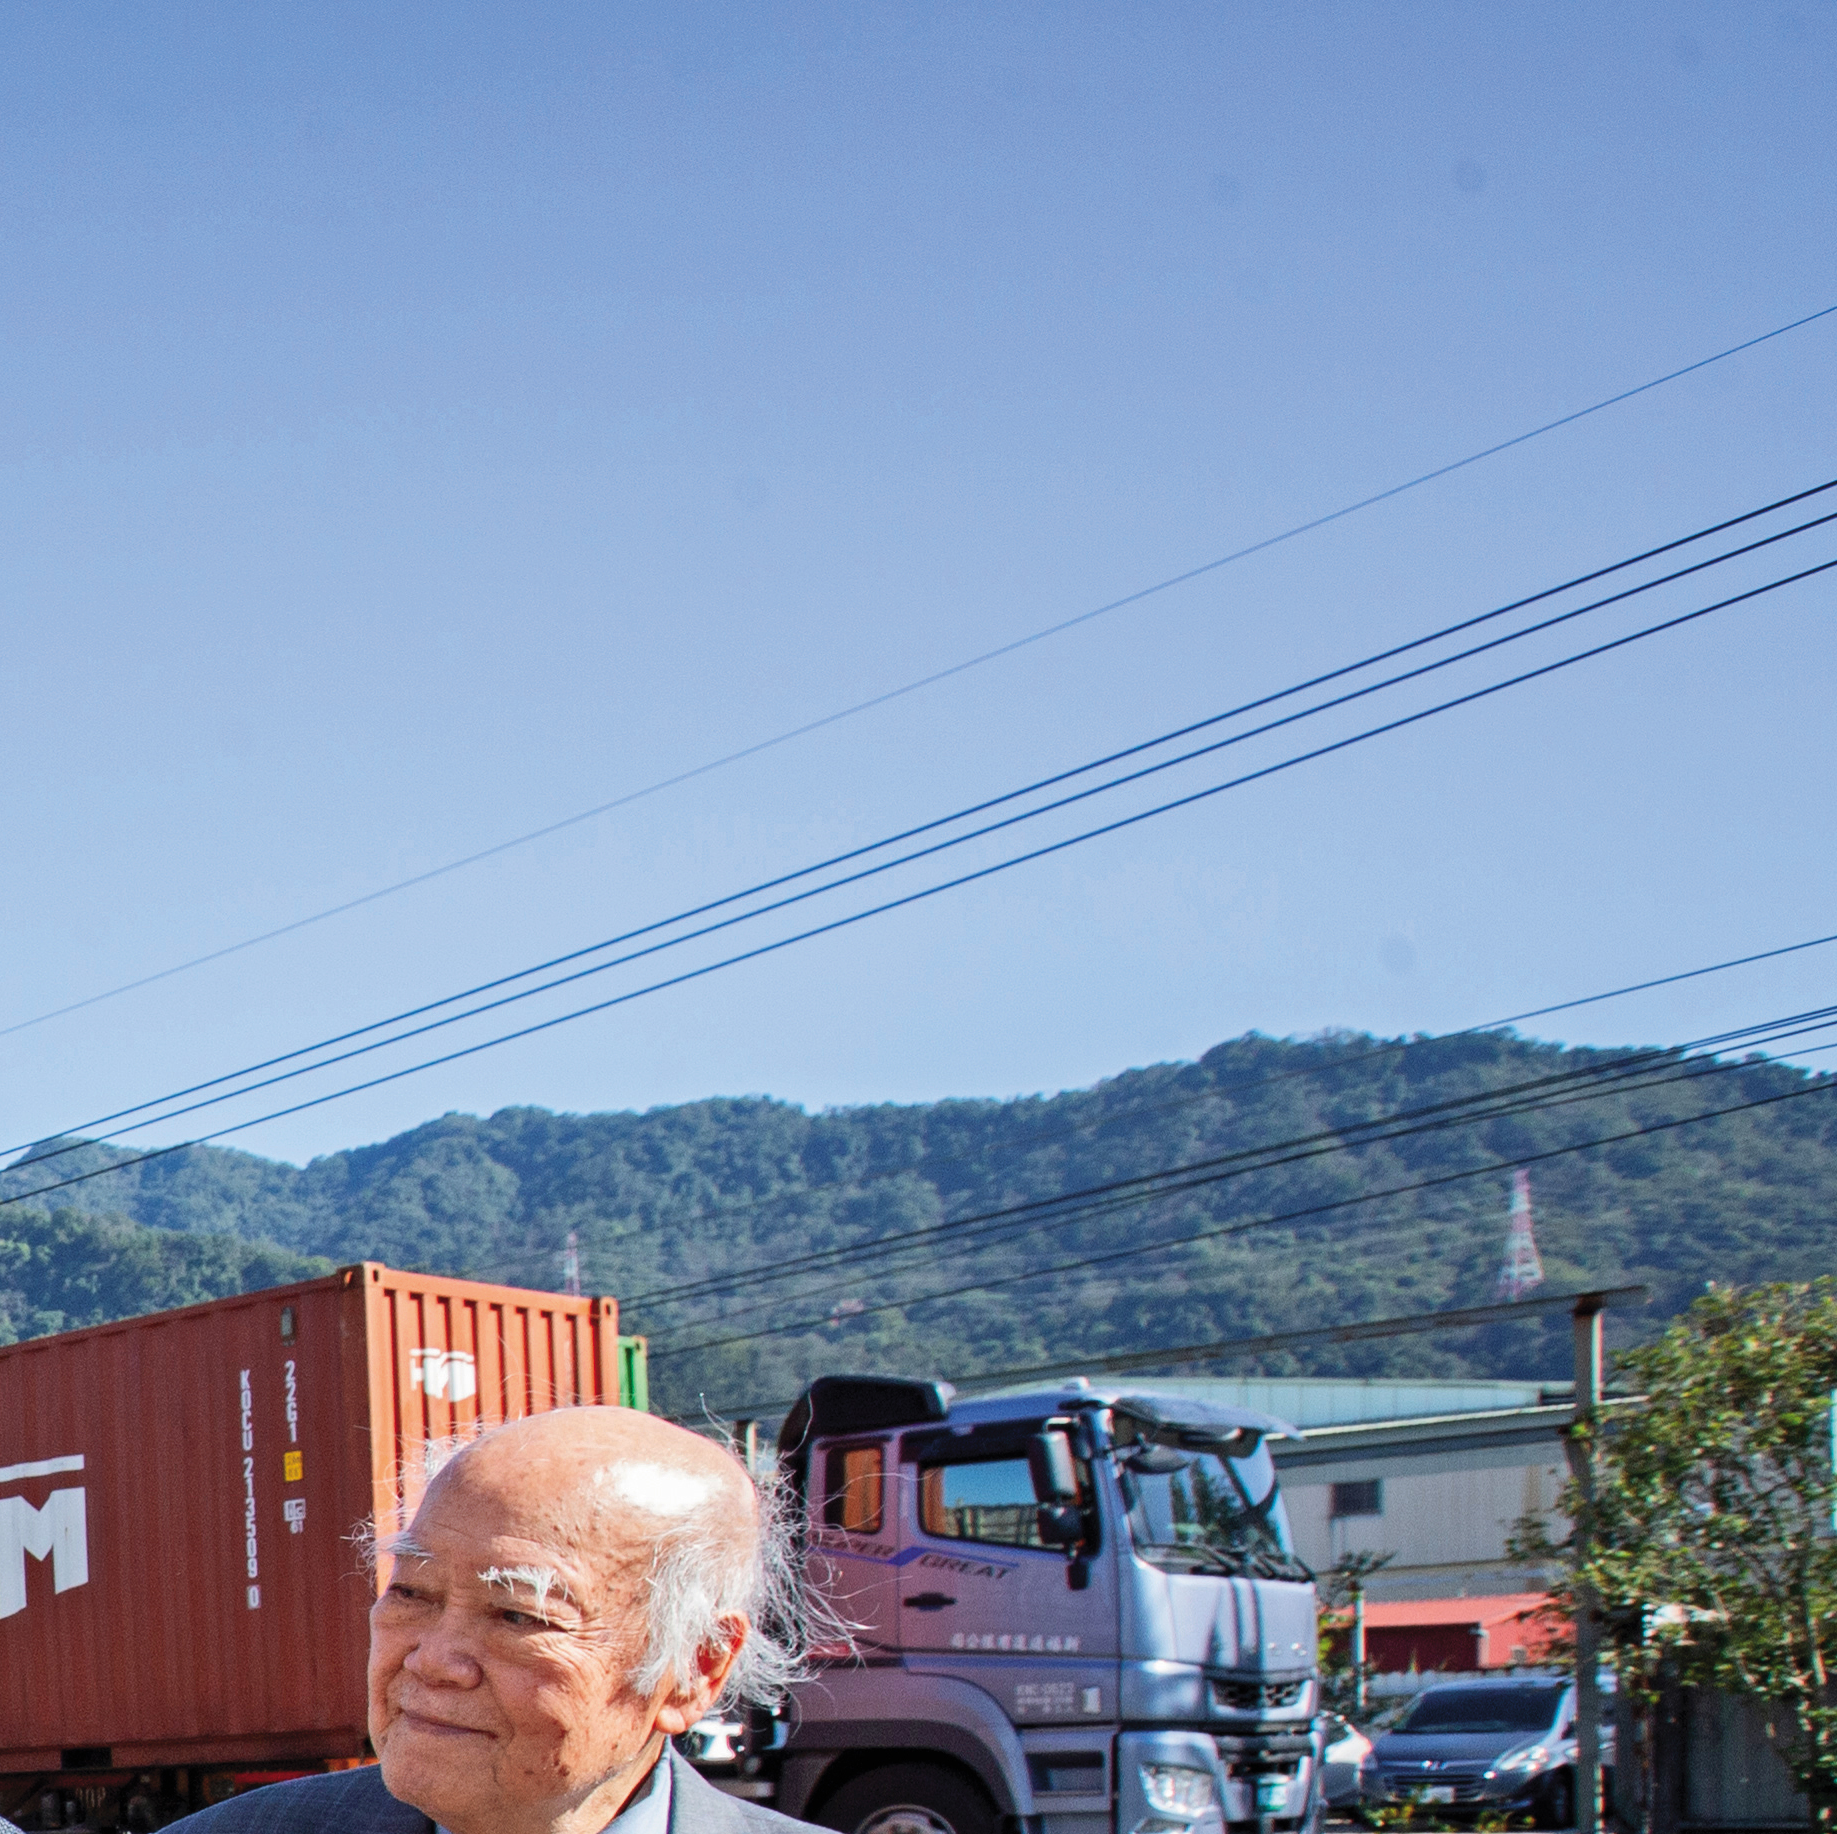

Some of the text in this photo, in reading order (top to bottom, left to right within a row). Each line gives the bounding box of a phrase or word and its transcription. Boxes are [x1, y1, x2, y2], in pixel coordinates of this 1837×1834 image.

[240, 1368, 253, 1451] KOCU
[284, 1360, 297, 1443] 22G1
[243, 1457, 258, 1578] 213509
